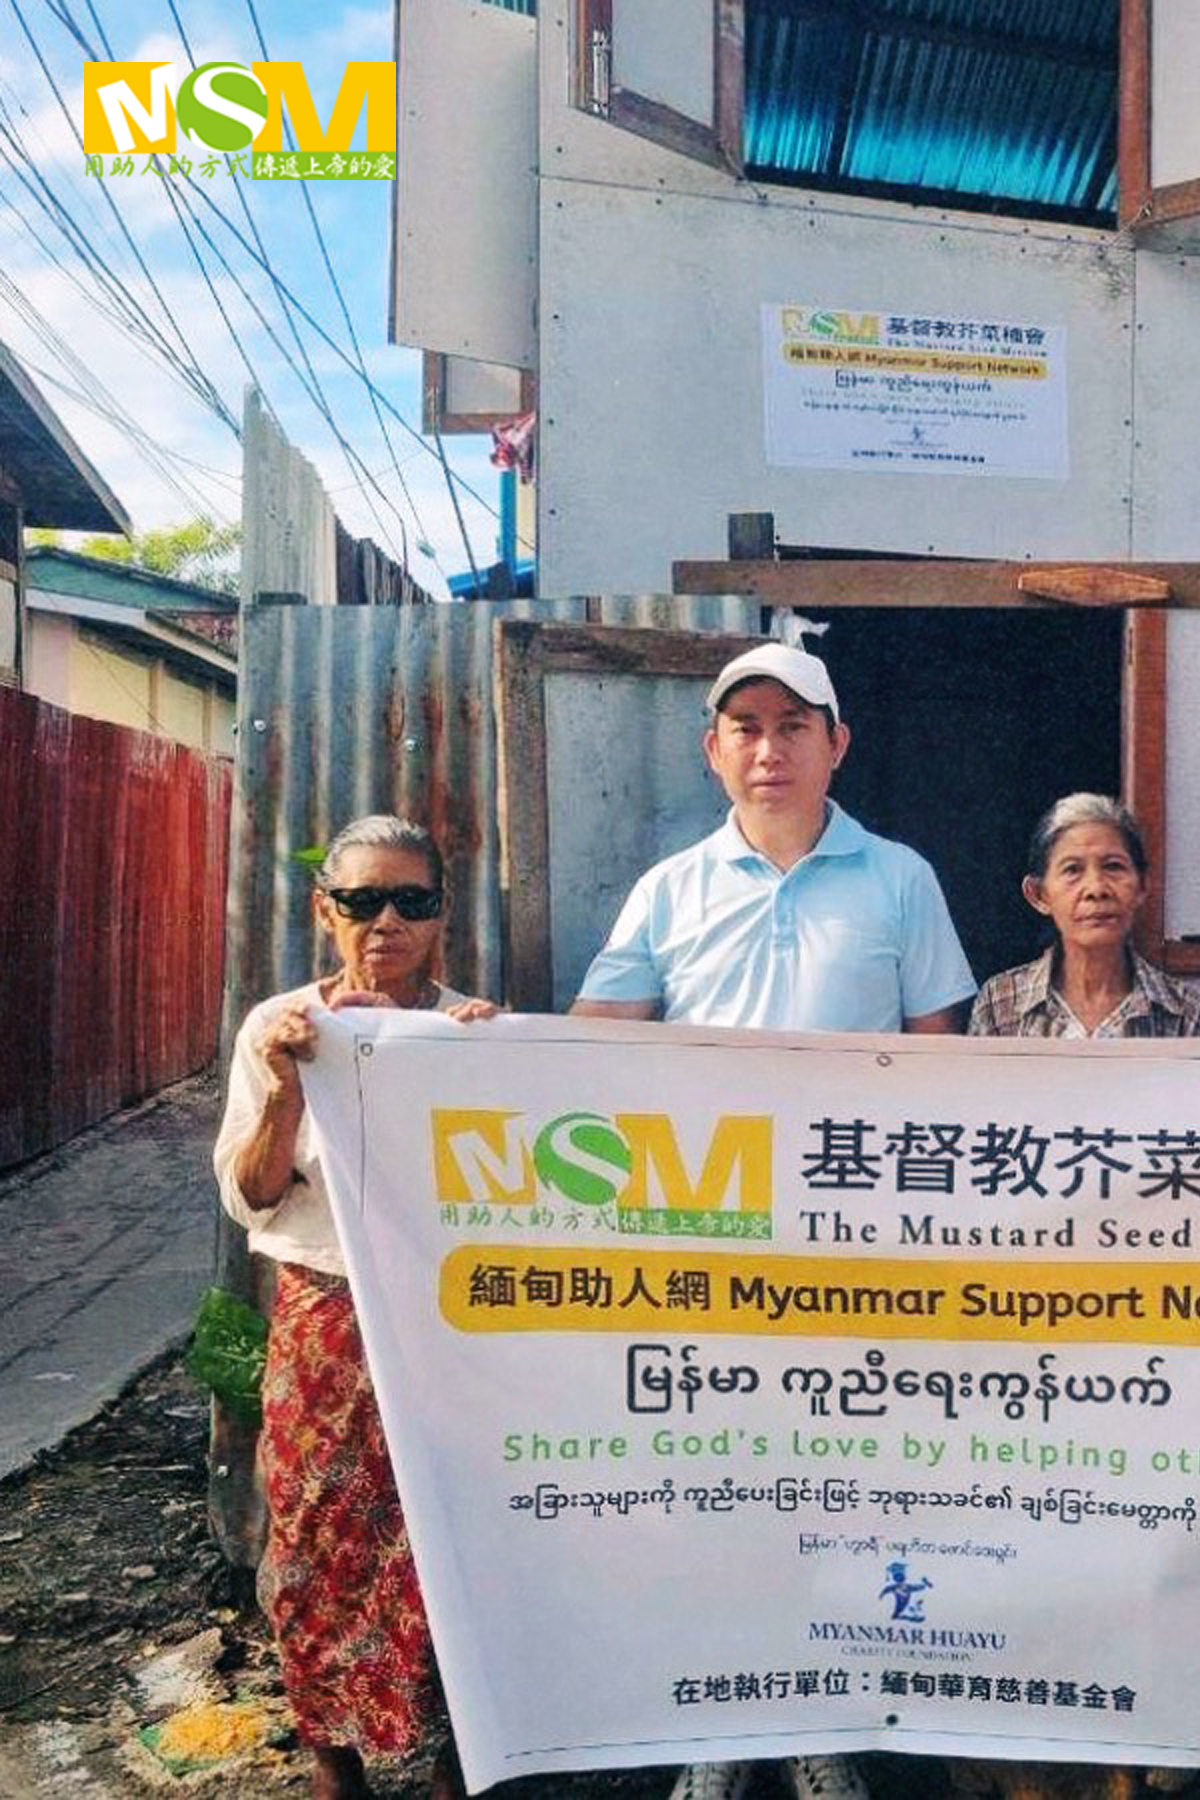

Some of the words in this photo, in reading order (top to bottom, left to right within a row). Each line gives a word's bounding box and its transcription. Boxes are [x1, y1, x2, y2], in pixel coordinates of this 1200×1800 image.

[431, 1108, 773, 1213] MSM
[800, 1211, 877, 1243] The
[900, 1214, 1074, 1247] Mustard
[1098, 1218, 1191, 1248] Seed
[469, 1264, 711, 1311] 緬甸助人網
[730, 1276, 944, 1320] Myanmar
[961, 1283, 1145, 1326] Support
[627, 1344, 759, 1414] မြန်မာ
[504, 1432, 627, 1461] Share
[652, 1430, 768, 1457] God's
[793, 1430, 878, 1458] love
[903, 1434, 946, 1466] by
[971, 1435, 1127, 1476] helping
[809, 1622, 928, 1646] MYANMAR
[930, 1628, 1007, 1650] HUAYU
